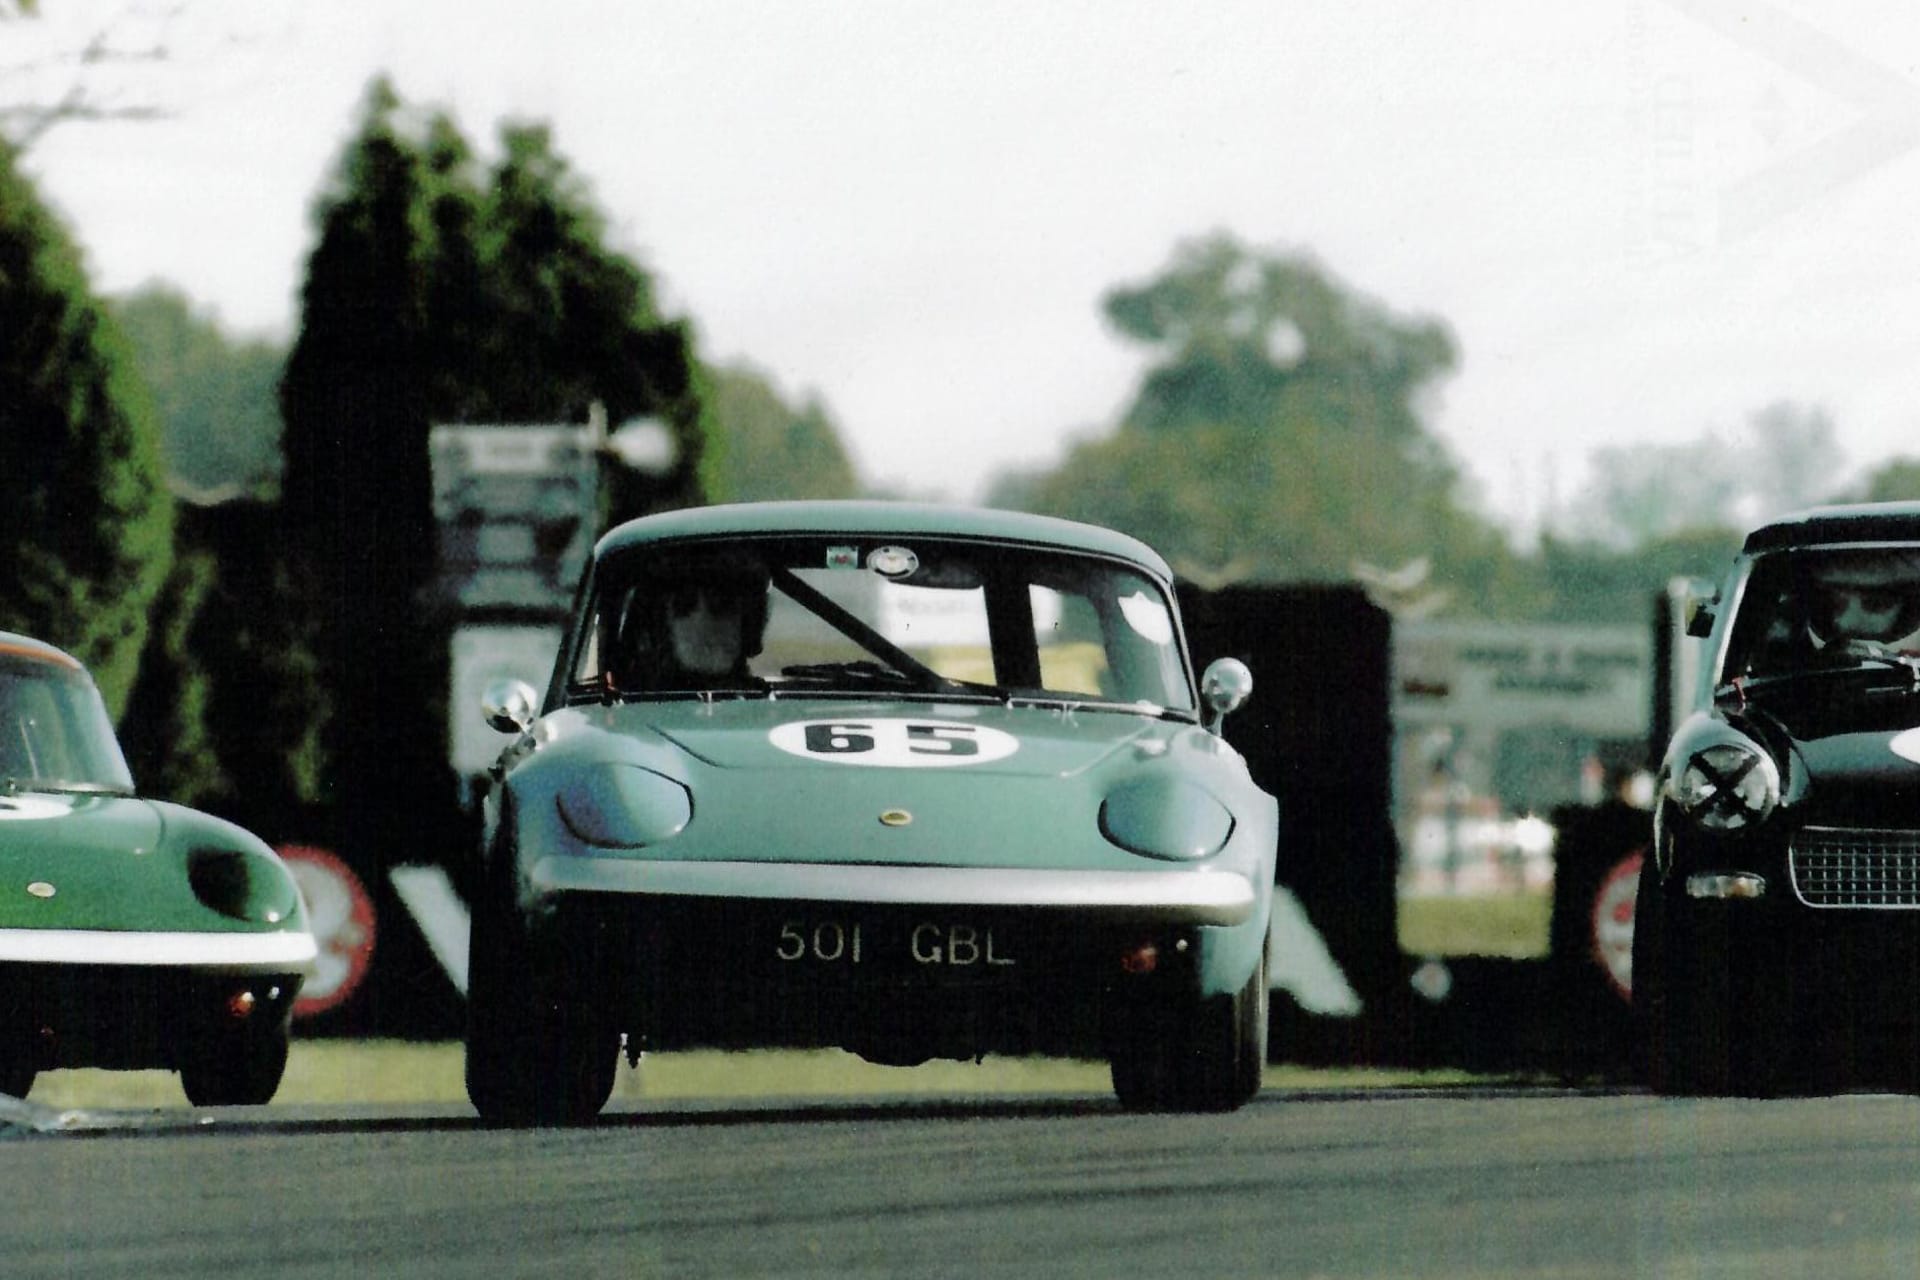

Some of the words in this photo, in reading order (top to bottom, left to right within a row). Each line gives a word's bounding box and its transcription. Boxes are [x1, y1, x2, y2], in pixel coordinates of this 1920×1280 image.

[804, 724, 980, 756] 65
[776, 922, 862, 963] 501
[911, 922, 1016, 965] GBL
